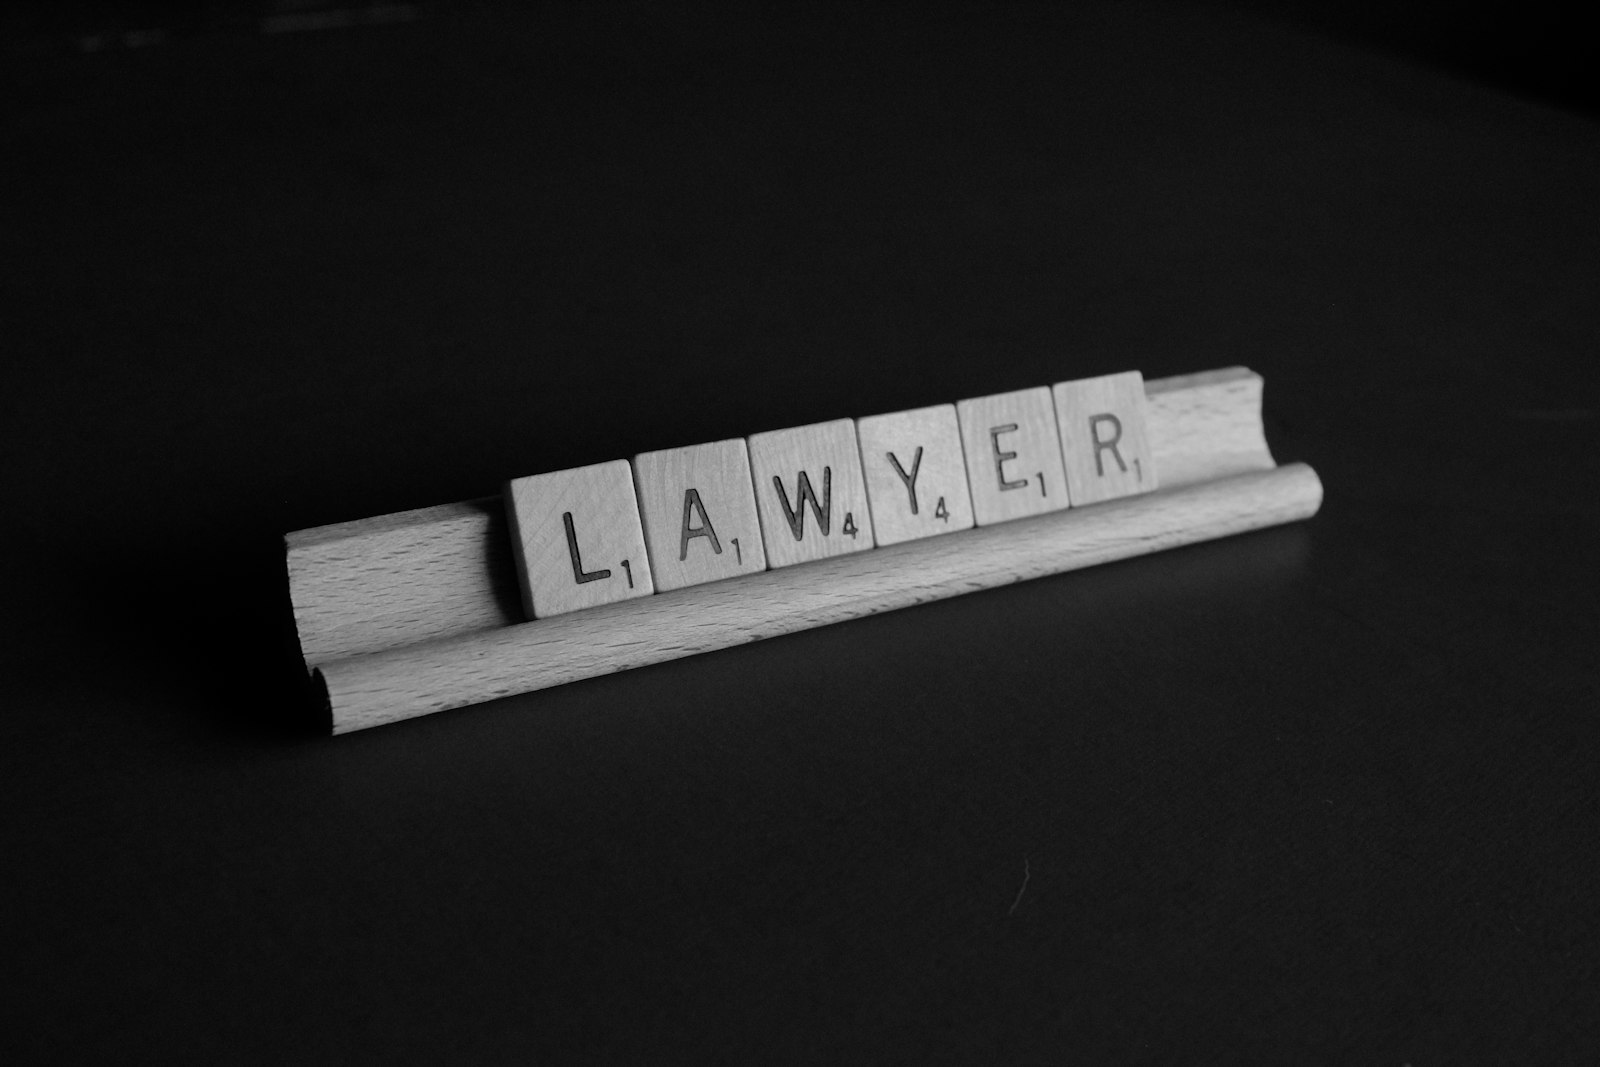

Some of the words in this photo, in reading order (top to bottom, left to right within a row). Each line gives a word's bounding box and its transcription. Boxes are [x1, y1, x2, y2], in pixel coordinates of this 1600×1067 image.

[1133, 458, 1143, 482] 1
[562, 412, 1127, 585] LAWYER
[1036, 471, 1047, 498] 1
[935, 496, 950, 524] 4
[842, 512, 858, 540] 4
[730, 537, 742, 565] 1
[620, 559, 634, 589] 1
